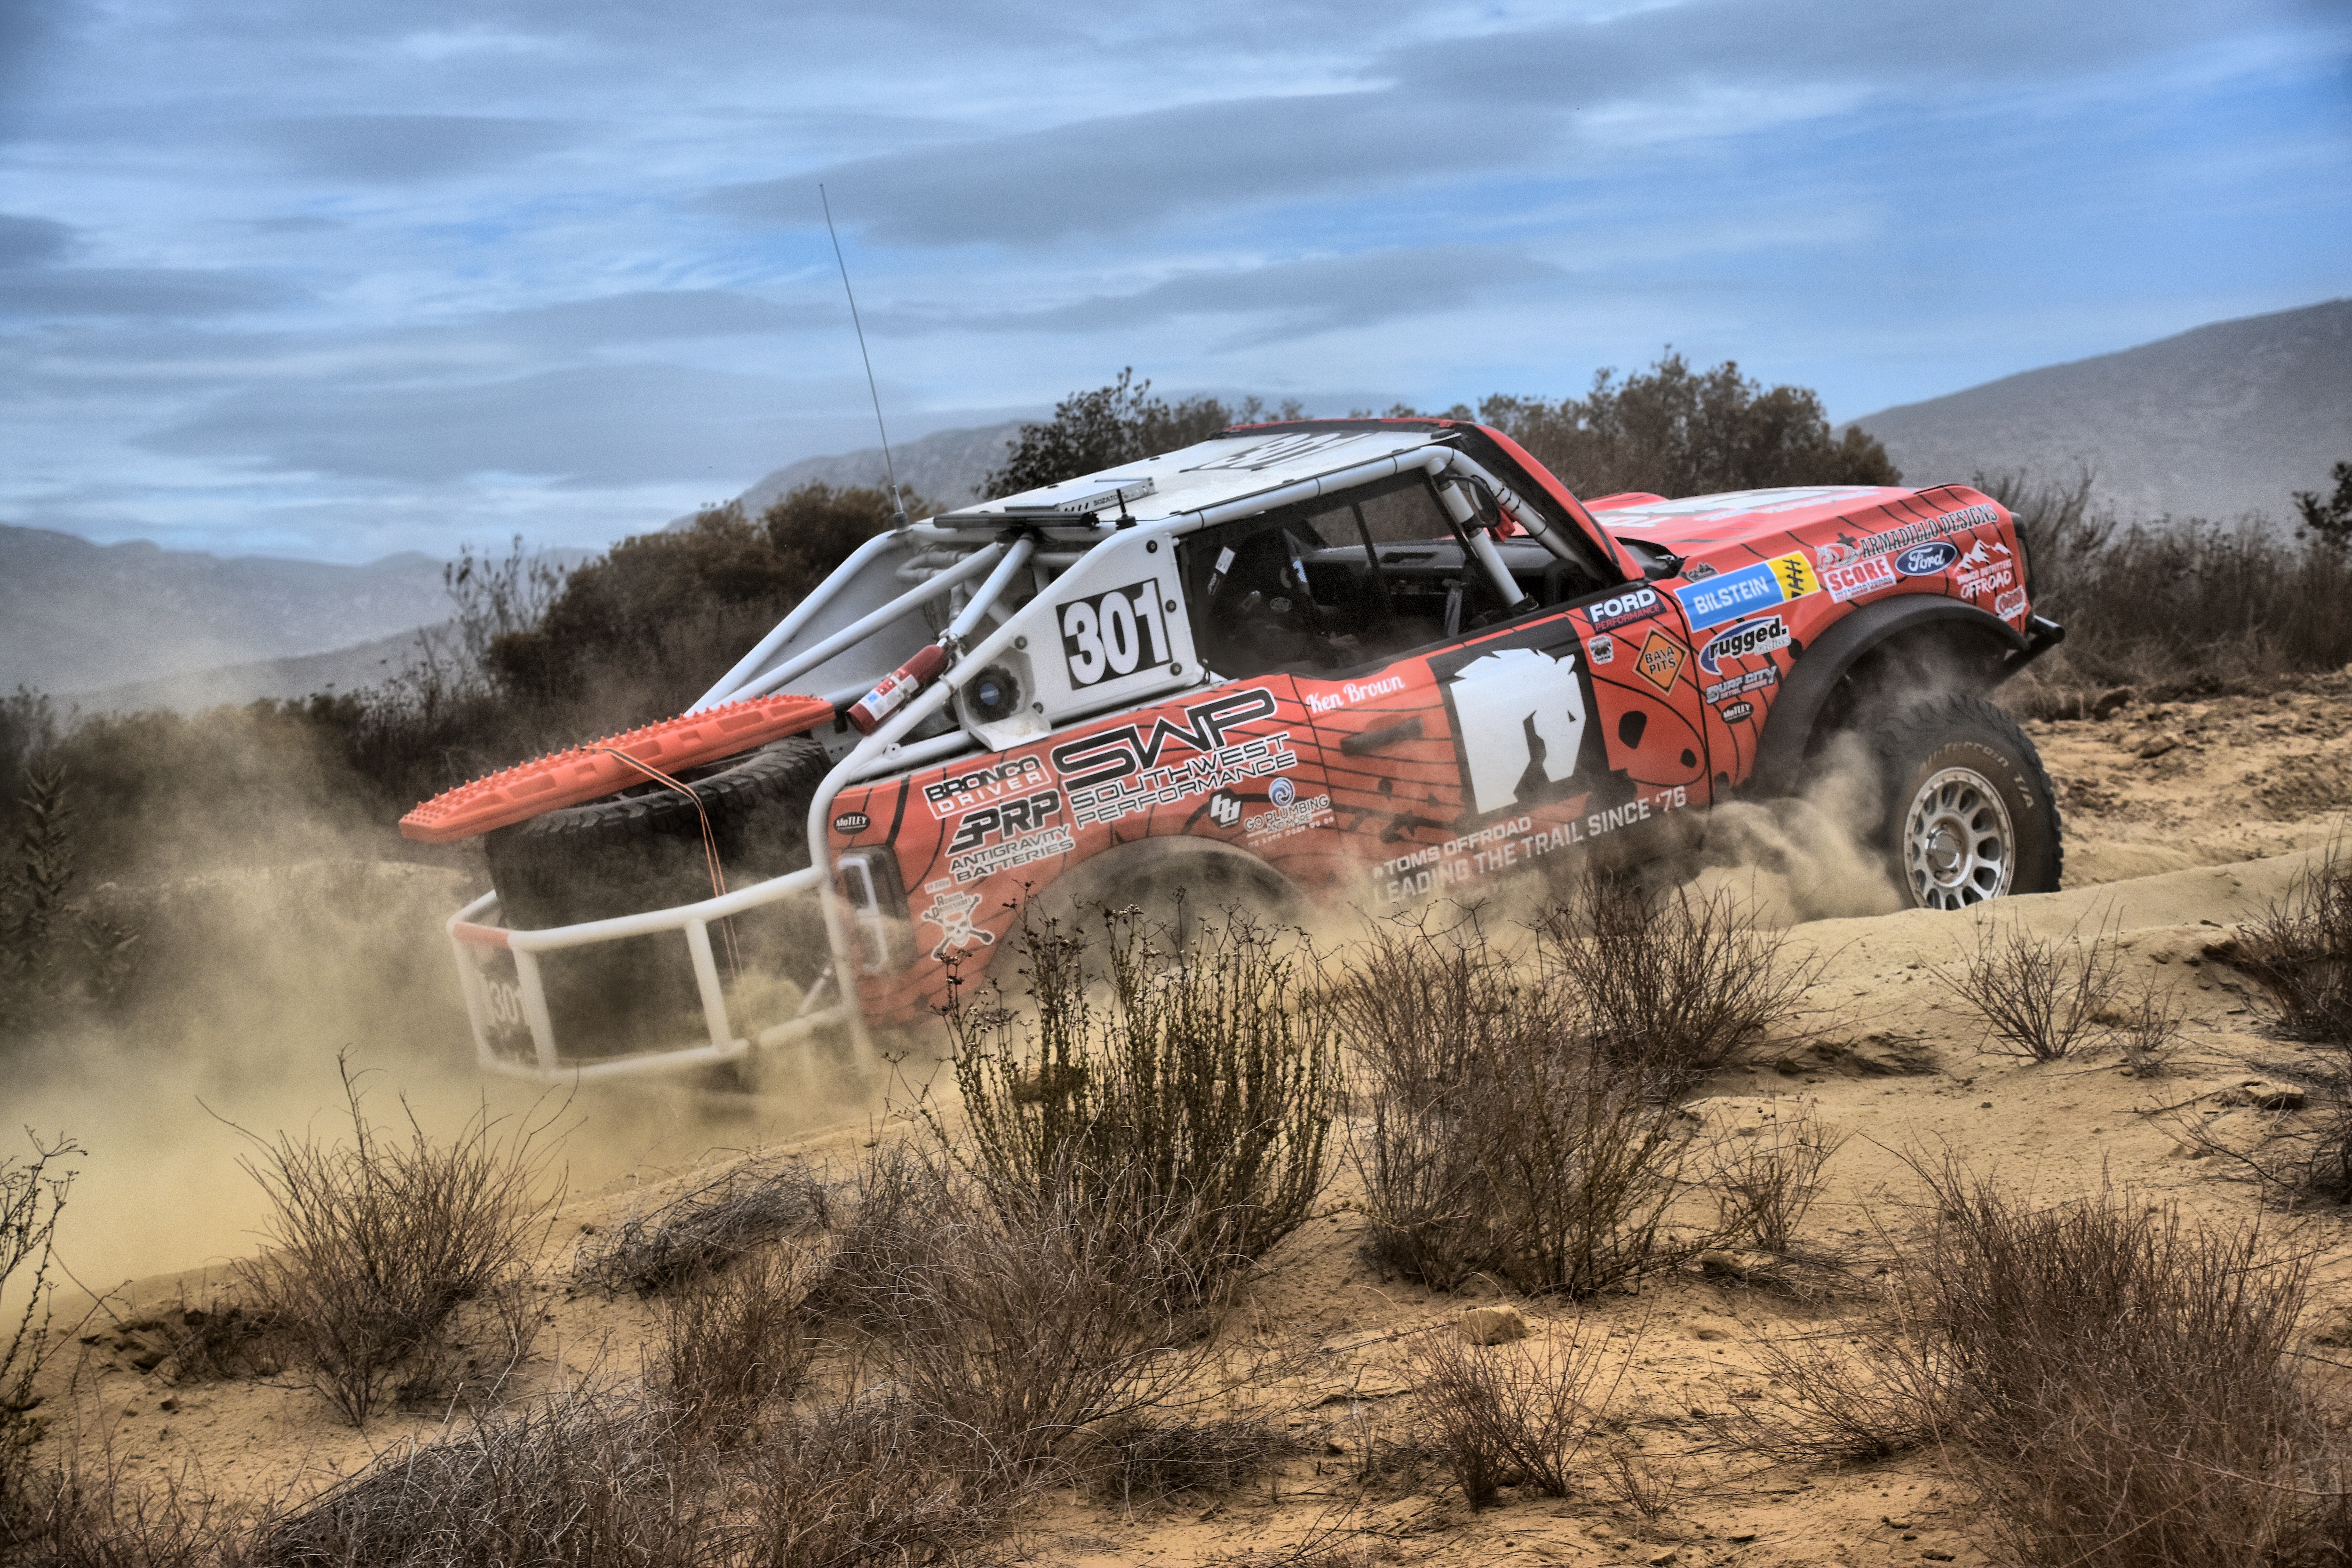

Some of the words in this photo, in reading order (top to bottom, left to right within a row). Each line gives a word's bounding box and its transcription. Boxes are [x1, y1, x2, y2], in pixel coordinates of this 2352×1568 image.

[1860, 520, 1939, 557] ARMADILLO
[1942, 505, 1997, 533] DESIGNS
[1828, 559, 1890, 591] SCORE
[1908, 547, 1946, 572] Ford
[1693, 577, 1770, 615] BILSTEIN
[1960, 570, 2011, 599] OFFROAD
[1589, 589, 1657, 622] FORD
[1595, 604, 1660, 631] PERFORMANCE
[1064, 581, 1161, 685] 301
[1649, 657, 1676, 675] PITS
[1745, 665, 1777, 684] CITY
[1306, 692, 1343, 714] Ken
[1343, 676, 1404, 703] Brown
[1053, 689, 1276, 791] SWP
[925, 756, 1041, 803] BRONCO
[1071, 733, 1289, 810] SOUTHWEST
[1075, 752, 1296, 828] PERFORMANCE
[938, 772, 1042, 813] DRIVER
[1246, 816, 1263, 830] GO
[1265, 796, 1328, 822] PLUMBING
[946, 790, 1060, 855] PRP
[950, 826, 1070, 872] ANTIGRAVITY
[957, 841, 1074, 882] BATTERIES
[1373, 861, 1470, 905] LEADING
[1475, 844, 1517, 874] THE
[1520, 824, 1584, 860] TRAIL
[1588, 797, 1651, 836] SINCE
[1384, 847, 1439, 875] TOMS
[1444, 817, 1532, 856] OFFROAD
